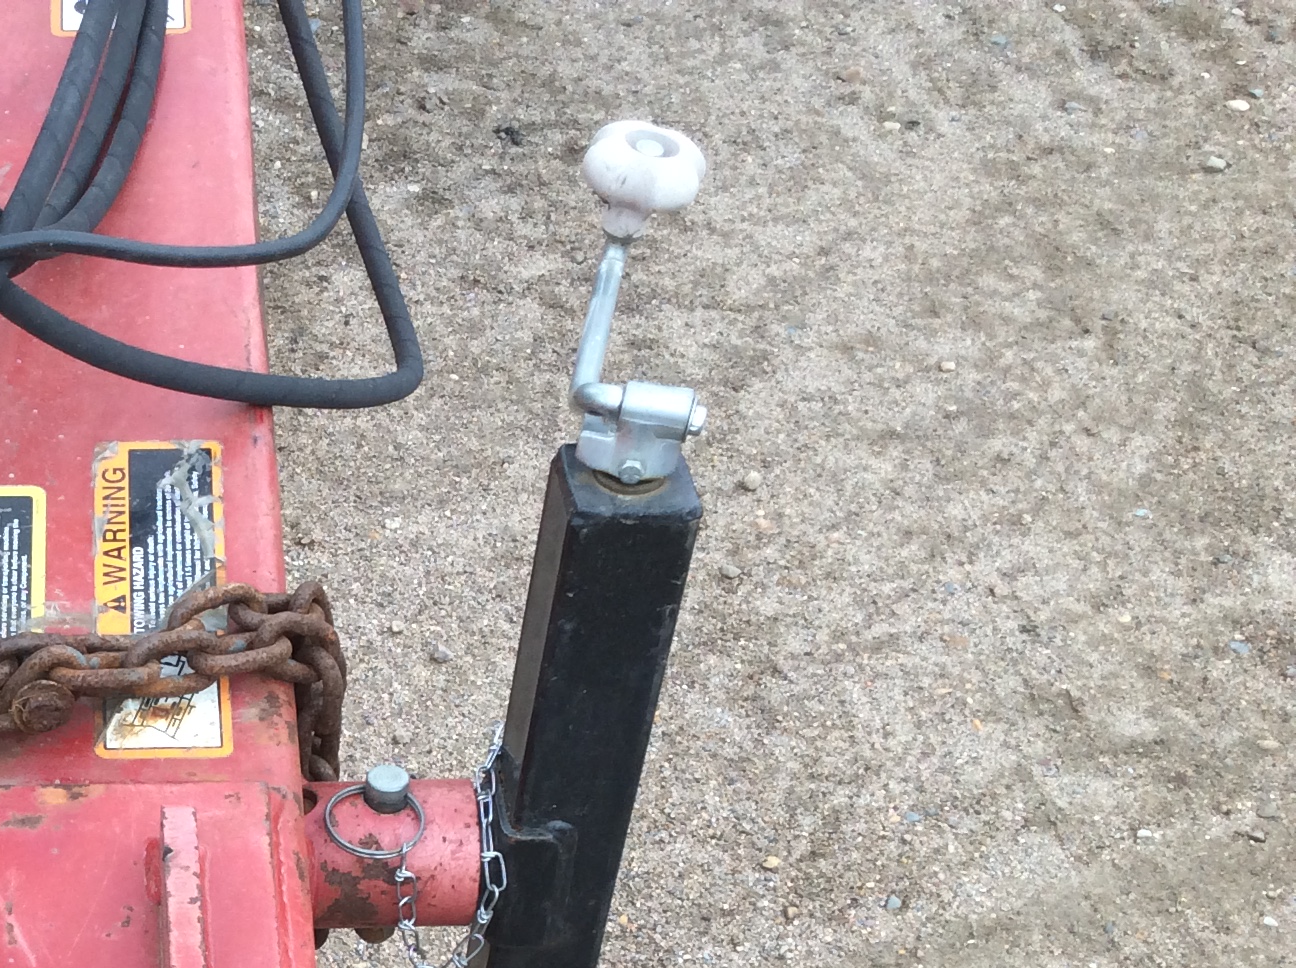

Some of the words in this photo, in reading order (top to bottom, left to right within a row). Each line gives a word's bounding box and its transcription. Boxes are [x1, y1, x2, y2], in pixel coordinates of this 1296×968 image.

[102, 468, 127, 585] WARNING
[132, 547, 144, 589] HAZARD
[132, 592, 145, 633] TOWING
